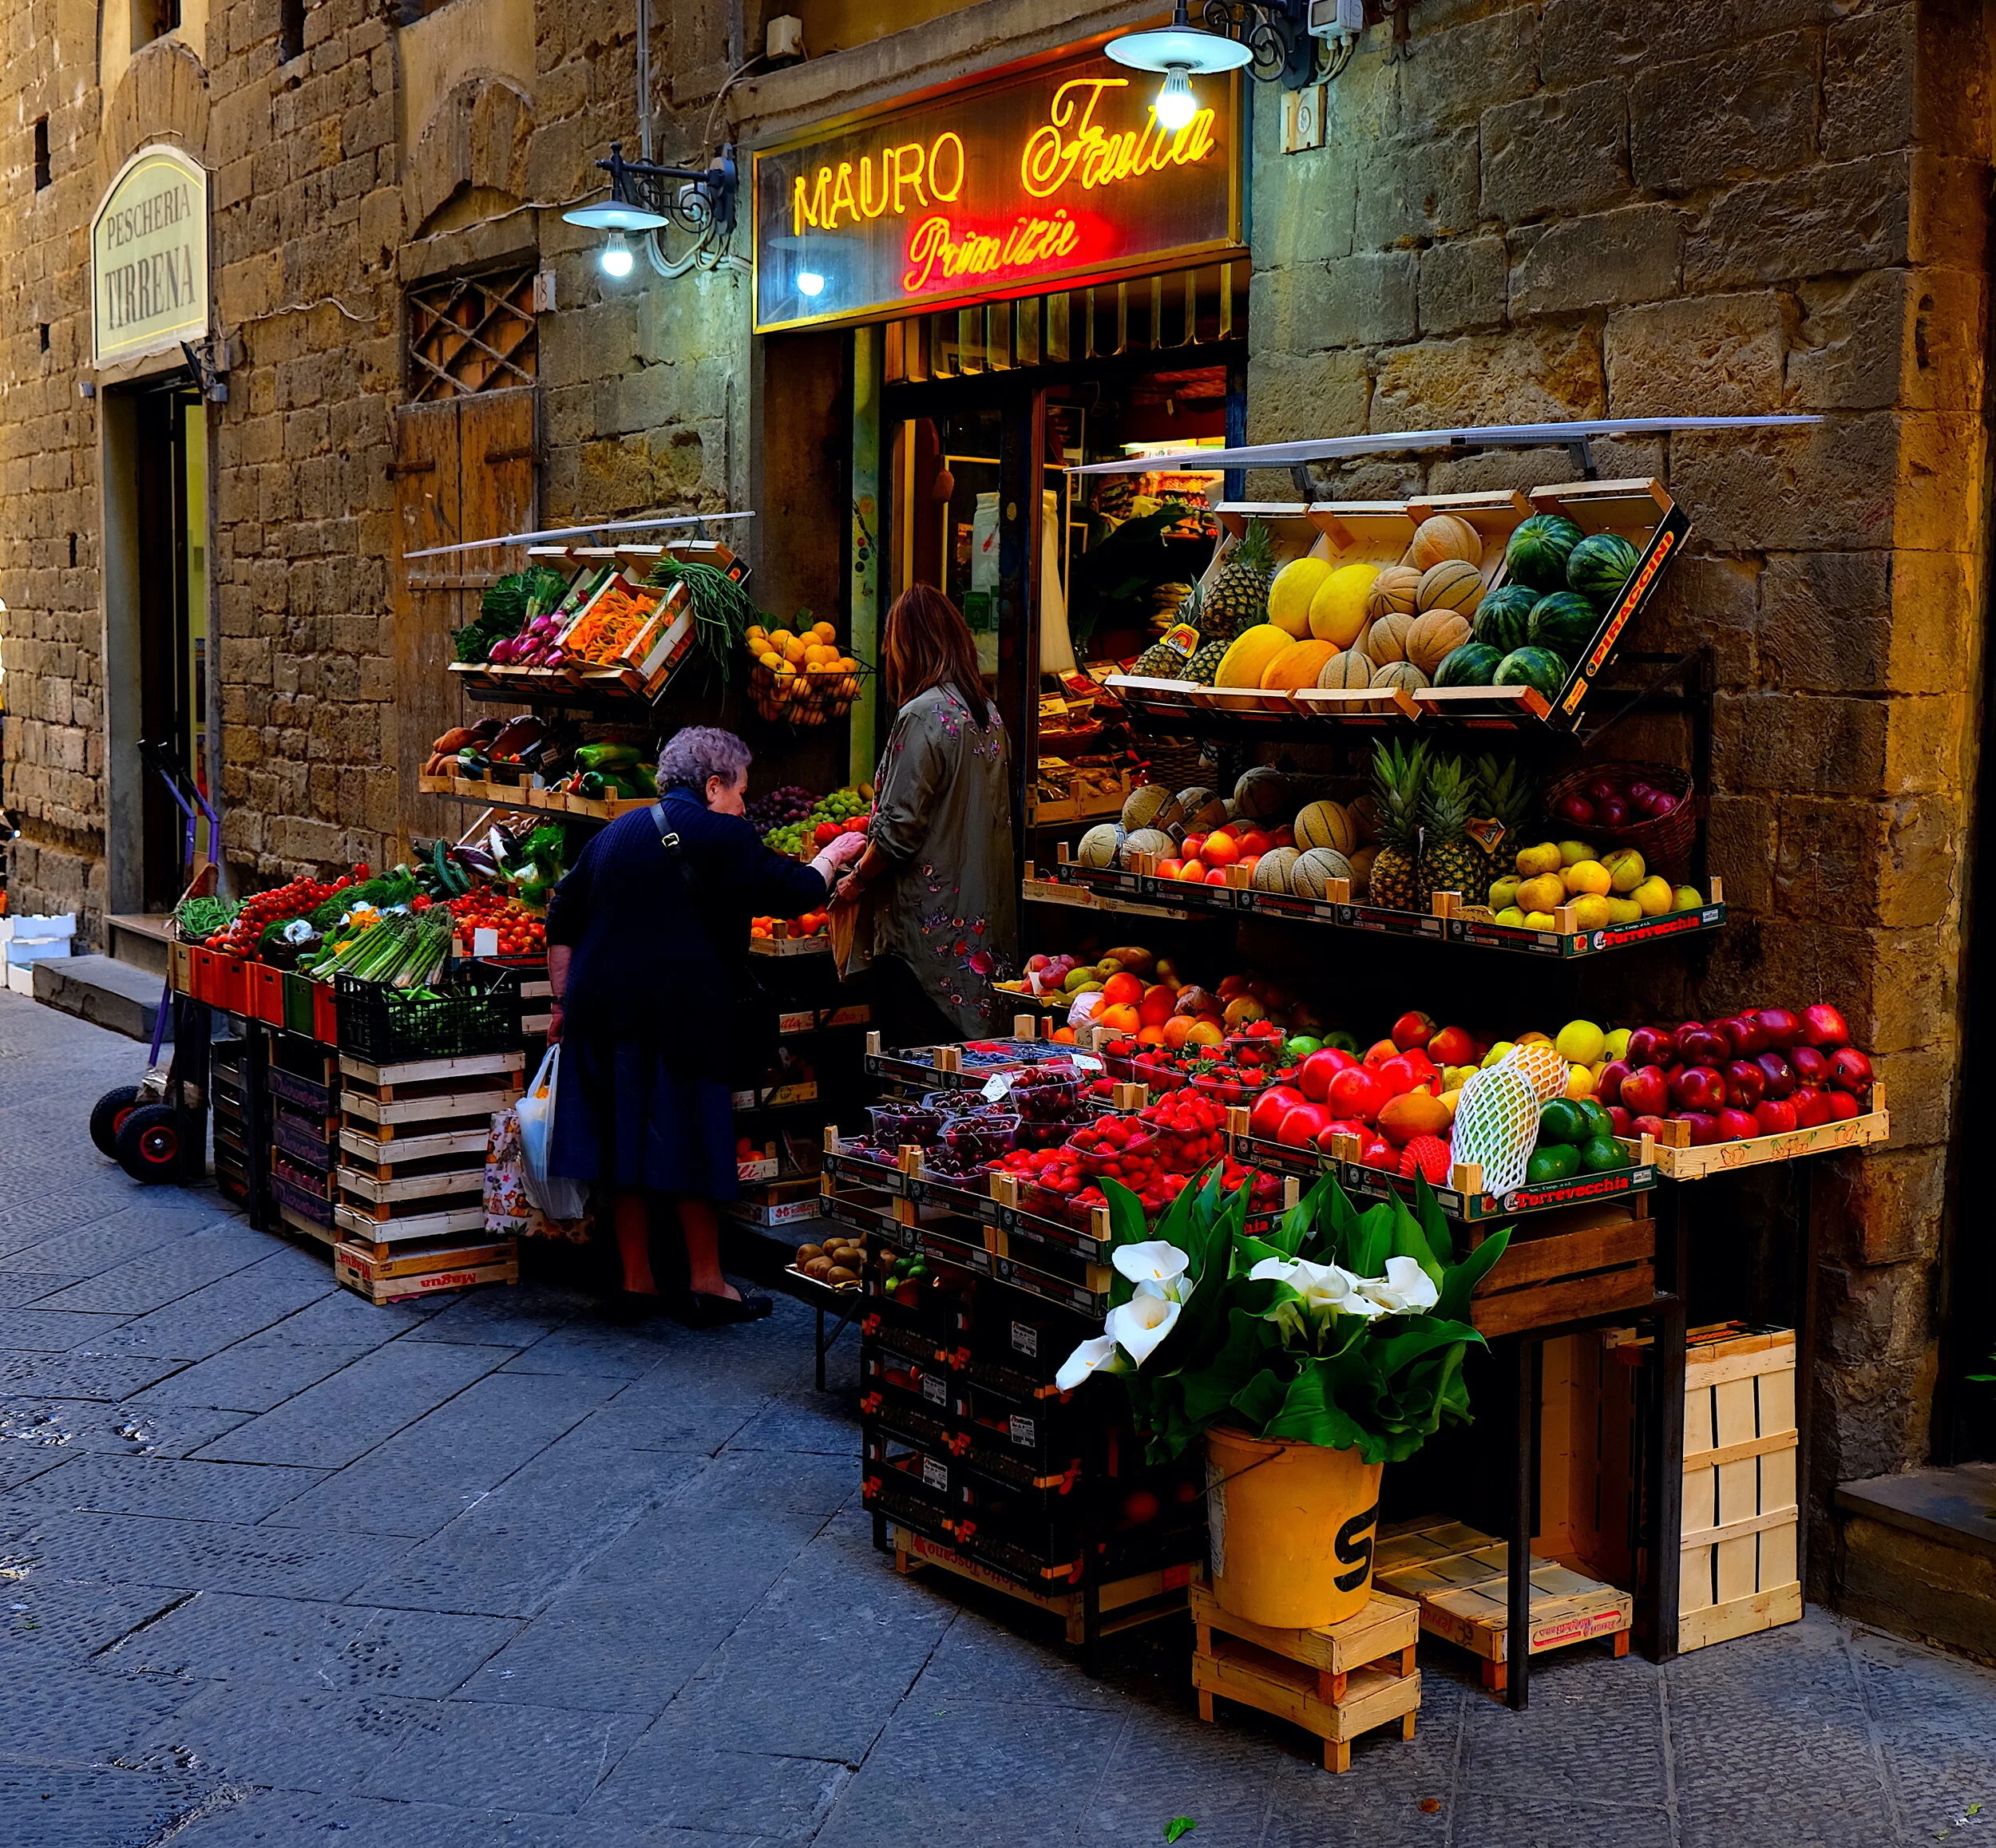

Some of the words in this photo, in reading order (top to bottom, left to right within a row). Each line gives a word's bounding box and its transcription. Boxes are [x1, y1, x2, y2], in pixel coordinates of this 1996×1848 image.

[794, 132, 964, 235] MAURO
[107, 184, 191, 251] PESCHERIA
[105, 243, 196, 330] TIRRENA
[536, 281, 548, 304] 18
[1593, 533, 1672, 665] PIRACCINI
[1603, 916, 1700, 947] Torrevecchia
[1515, 1176, 1630, 1209] Torrevecchia
[339, 1252, 371, 1280] Magua
[421, 1273, 477, 1288] Magua
